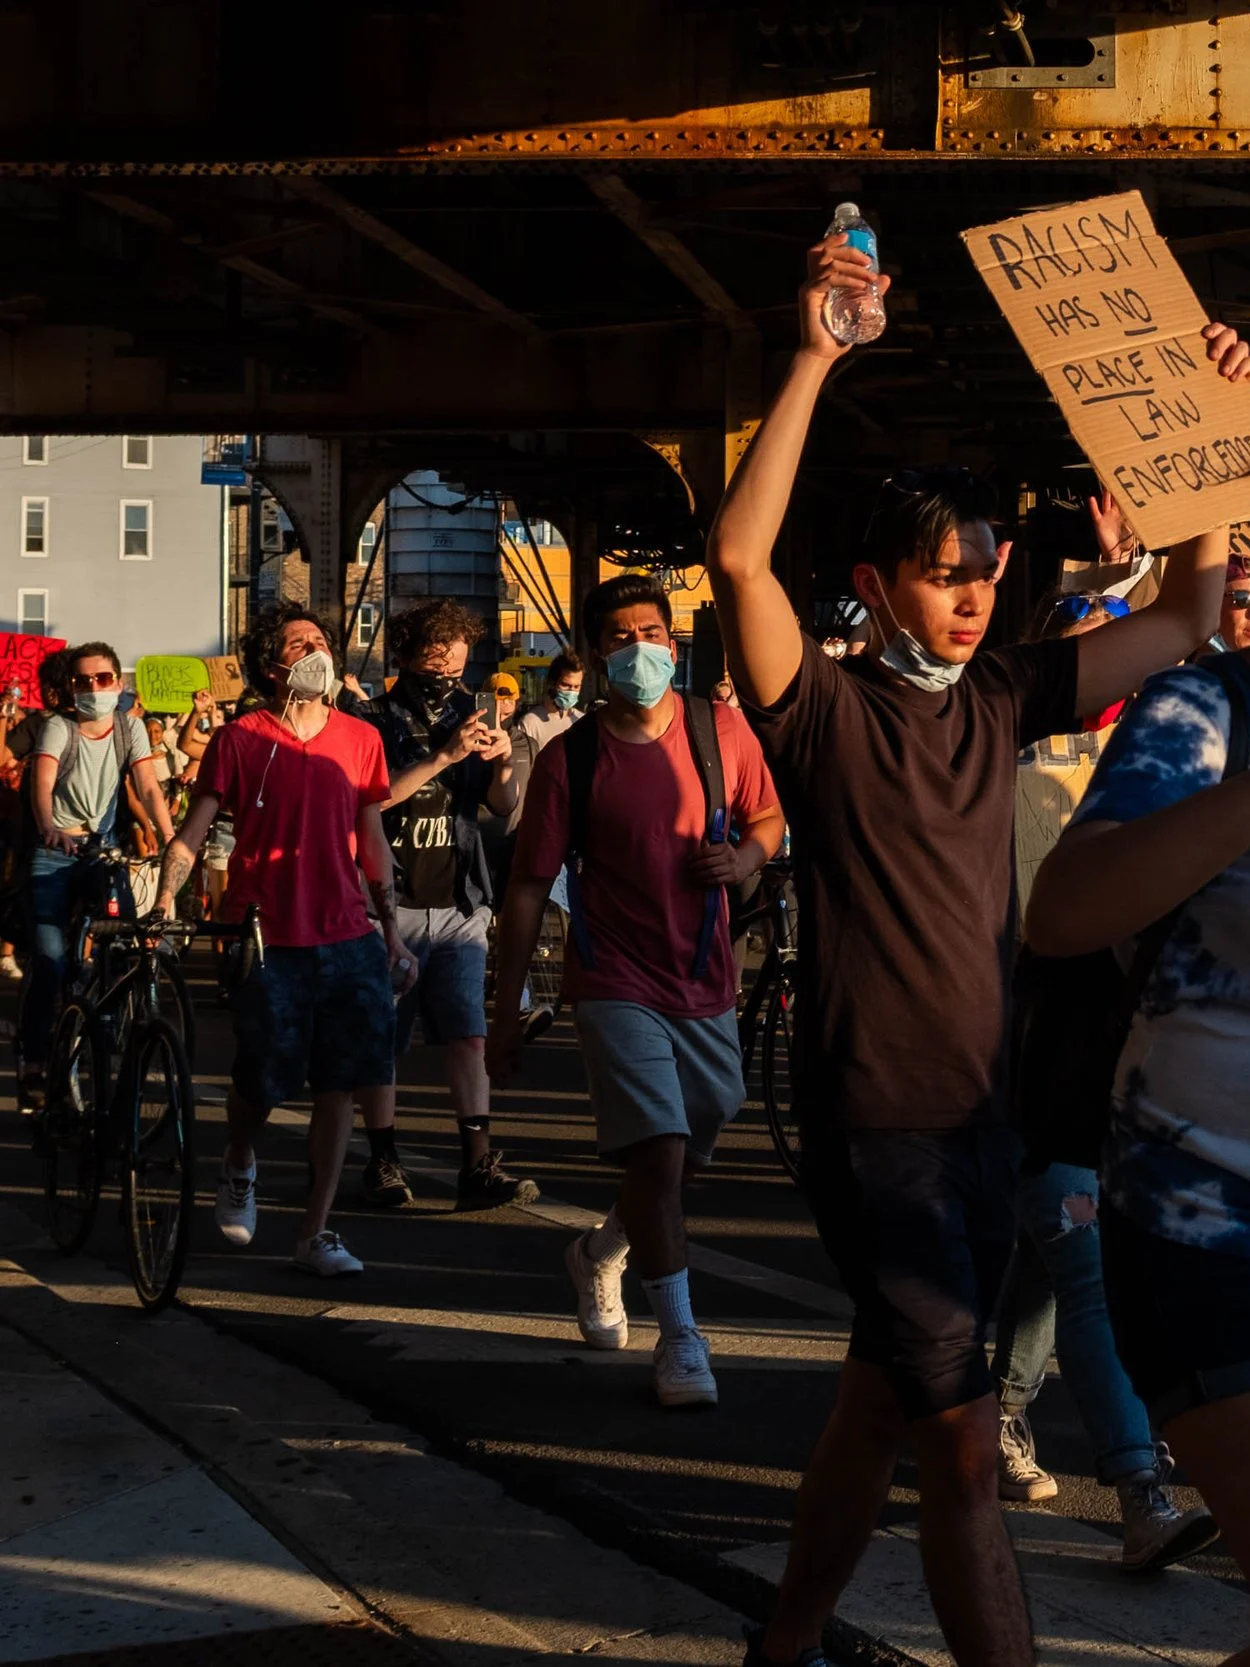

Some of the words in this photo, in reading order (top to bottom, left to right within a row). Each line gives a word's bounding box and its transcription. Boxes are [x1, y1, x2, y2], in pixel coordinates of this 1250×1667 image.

[987, 209, 1158, 290] RACISM
[1035, 296, 1100, 337] HAS
[1100, 287, 1154, 324] NO
[1061, 350, 1154, 395] PLACE
[1155, 337, 1198, 378] IN
[1119, 391, 1201, 442] LAW
